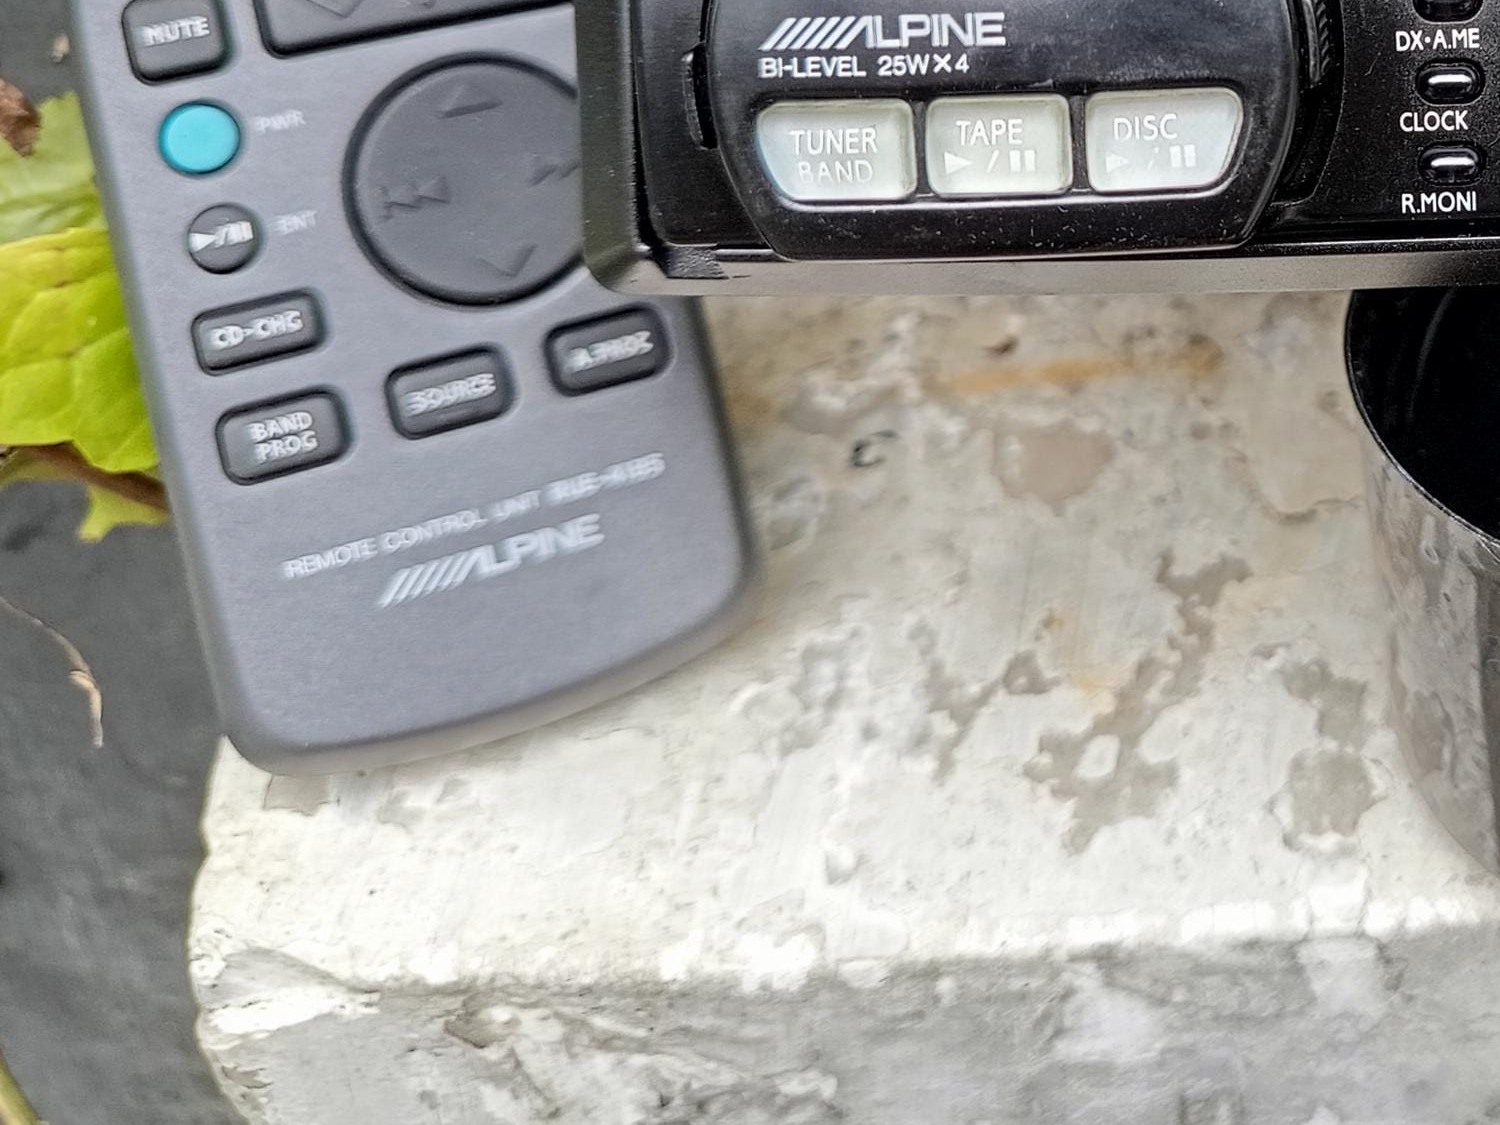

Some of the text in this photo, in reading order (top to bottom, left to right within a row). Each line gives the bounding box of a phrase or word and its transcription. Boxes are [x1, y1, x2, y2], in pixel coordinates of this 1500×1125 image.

[143, 15, 211, 46] MUTE
[757, 55, 867, 79] BI-LEVEL
[956, 118, 1024, 147] TAPE
[1112, 113, 1178, 142] DISC
[1400, 110, 1469, 132] CLOCK
[791, 127, 879, 155] TUNER
[798, 158, 874, 184] BAND
[1401, 191, 1477, 214] R.MONI
[405, 372, 497, 417] SOURCE
[248, 411, 313, 445] BAND
[253, 431, 318, 463] PROG
[281, 538, 379, 579] REMOTE
[379, 509, 488, 552] CONTROL
